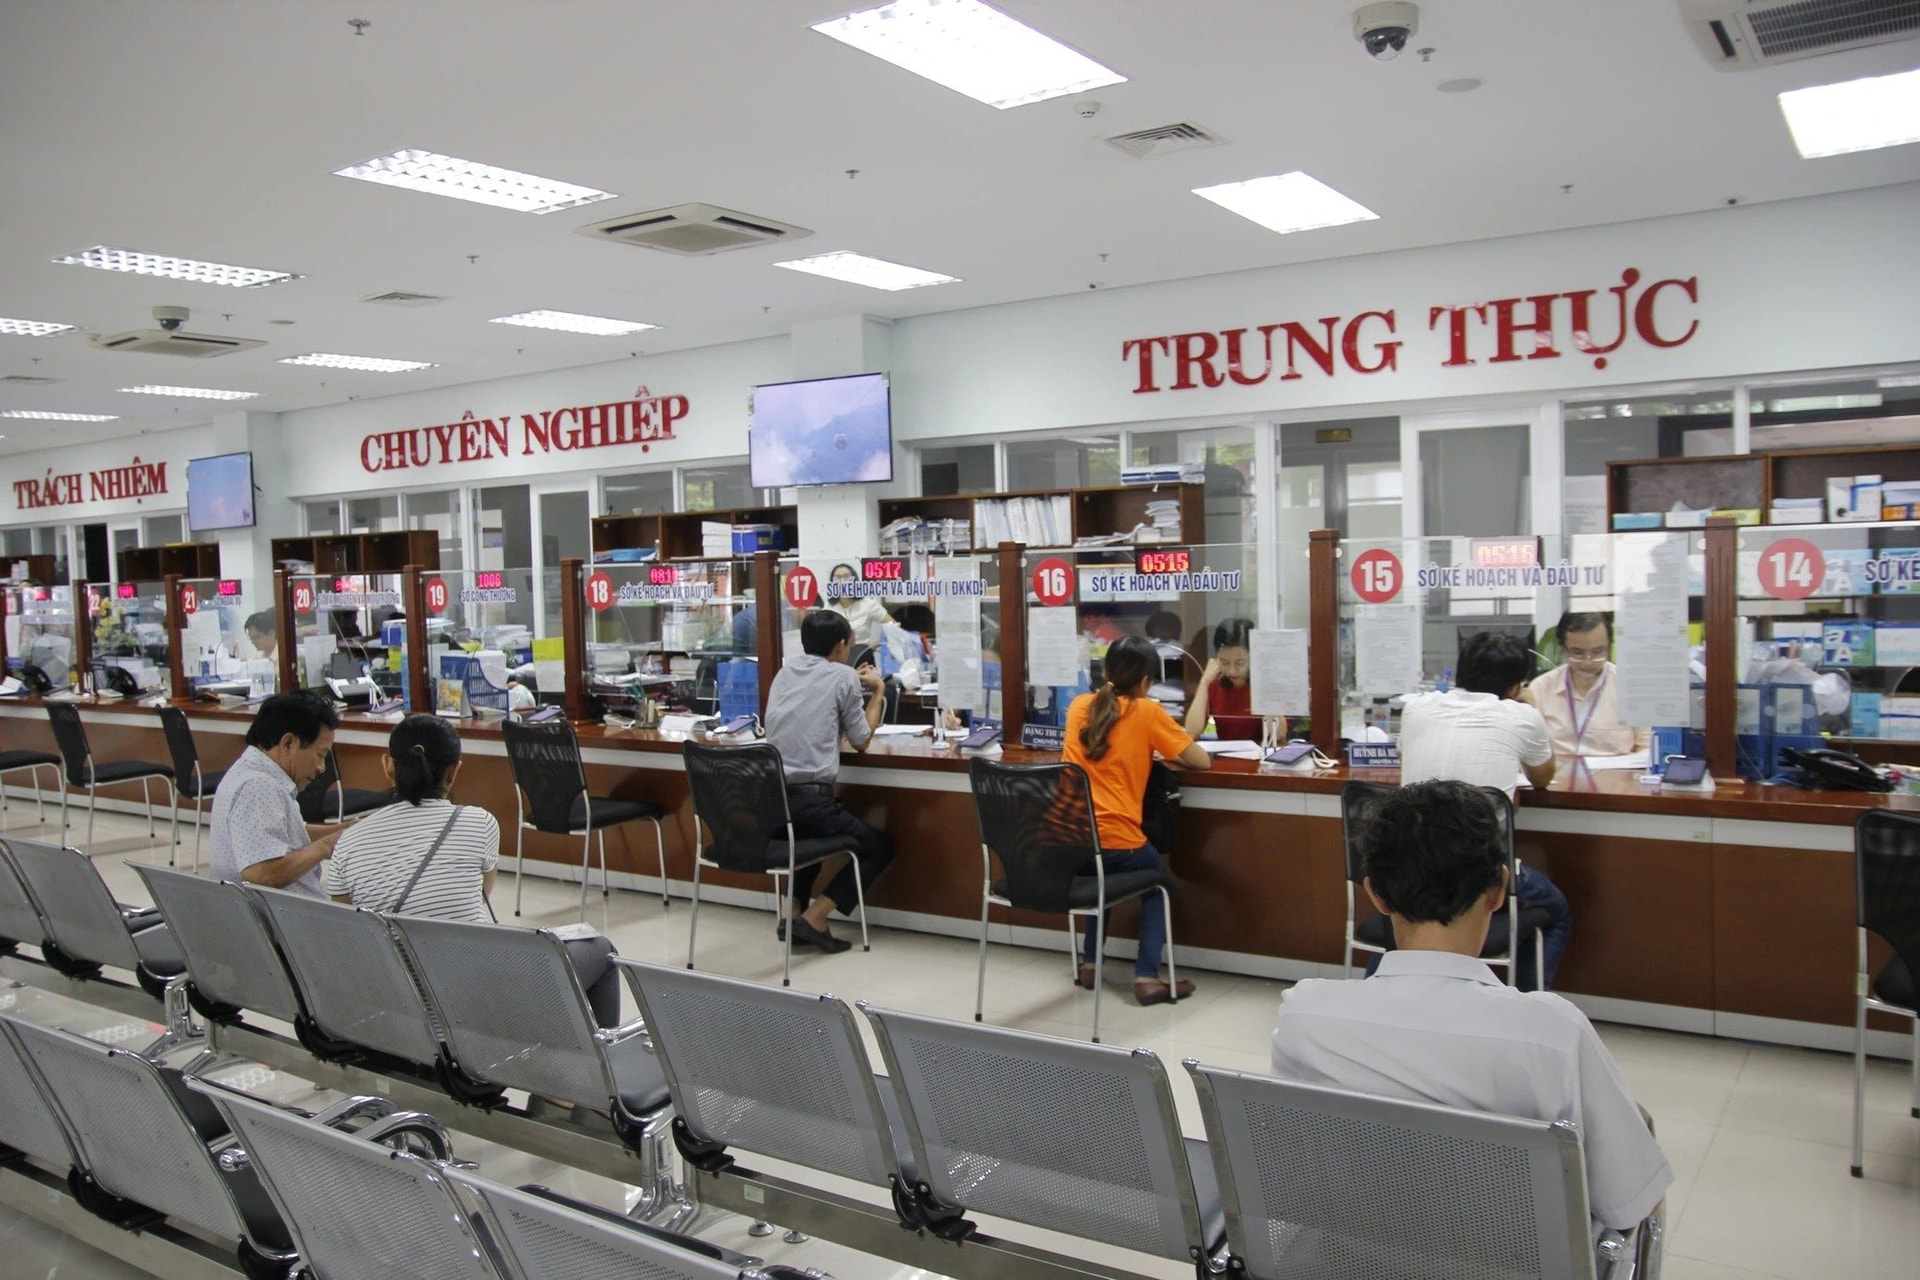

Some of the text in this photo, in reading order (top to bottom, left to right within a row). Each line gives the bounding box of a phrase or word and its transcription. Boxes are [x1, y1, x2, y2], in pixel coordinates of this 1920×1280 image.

[1123, 267, 1700, 394] TRUNG THỰC
[360, 384, 690, 473] CHUYÊN NGHIỆP
[13, 456, 169, 509] TRÁCH NHIỆM
[1141, 553, 1189, 573] 0515
[1477, 545, 1536, 566] 0516
[1865, 553, 1891, 582] SỞ
[478, 573, 502, 588] 1006
[864, 561, 902, 579] 0517
[1092, 566, 1241, 595] SỞ KẾ HOẠCH VÀ ĐẦU TƯ
[1360, 560, 1394, 592] 15
[1418, 559, 1606, 590] SỞ KẾ HOẠCH VÀ ĐẦU TƯ
[1769, 552, 1813, 587] 14
[591, 580, 608, 603] 18
[633, 581, 645, 600] KẾ
[644, 584, 671, 601] HOẠCH
[790, 575, 812, 601] 17
[826, 575, 840, 598] SỞ
[841, 575, 856, 598] KẾ
[856, 580, 888, 599] HOẠCH
[891, 578, 905, 597] VÀ
[906, 575, 926, 597] ĐẦU
[928, 578, 943, 597] TƯ
[1039, 568, 1066, 597] 16
[185, 591, 196, 609] 21
[296, 588, 310, 608] 20
[430, 585, 444, 606] 19
